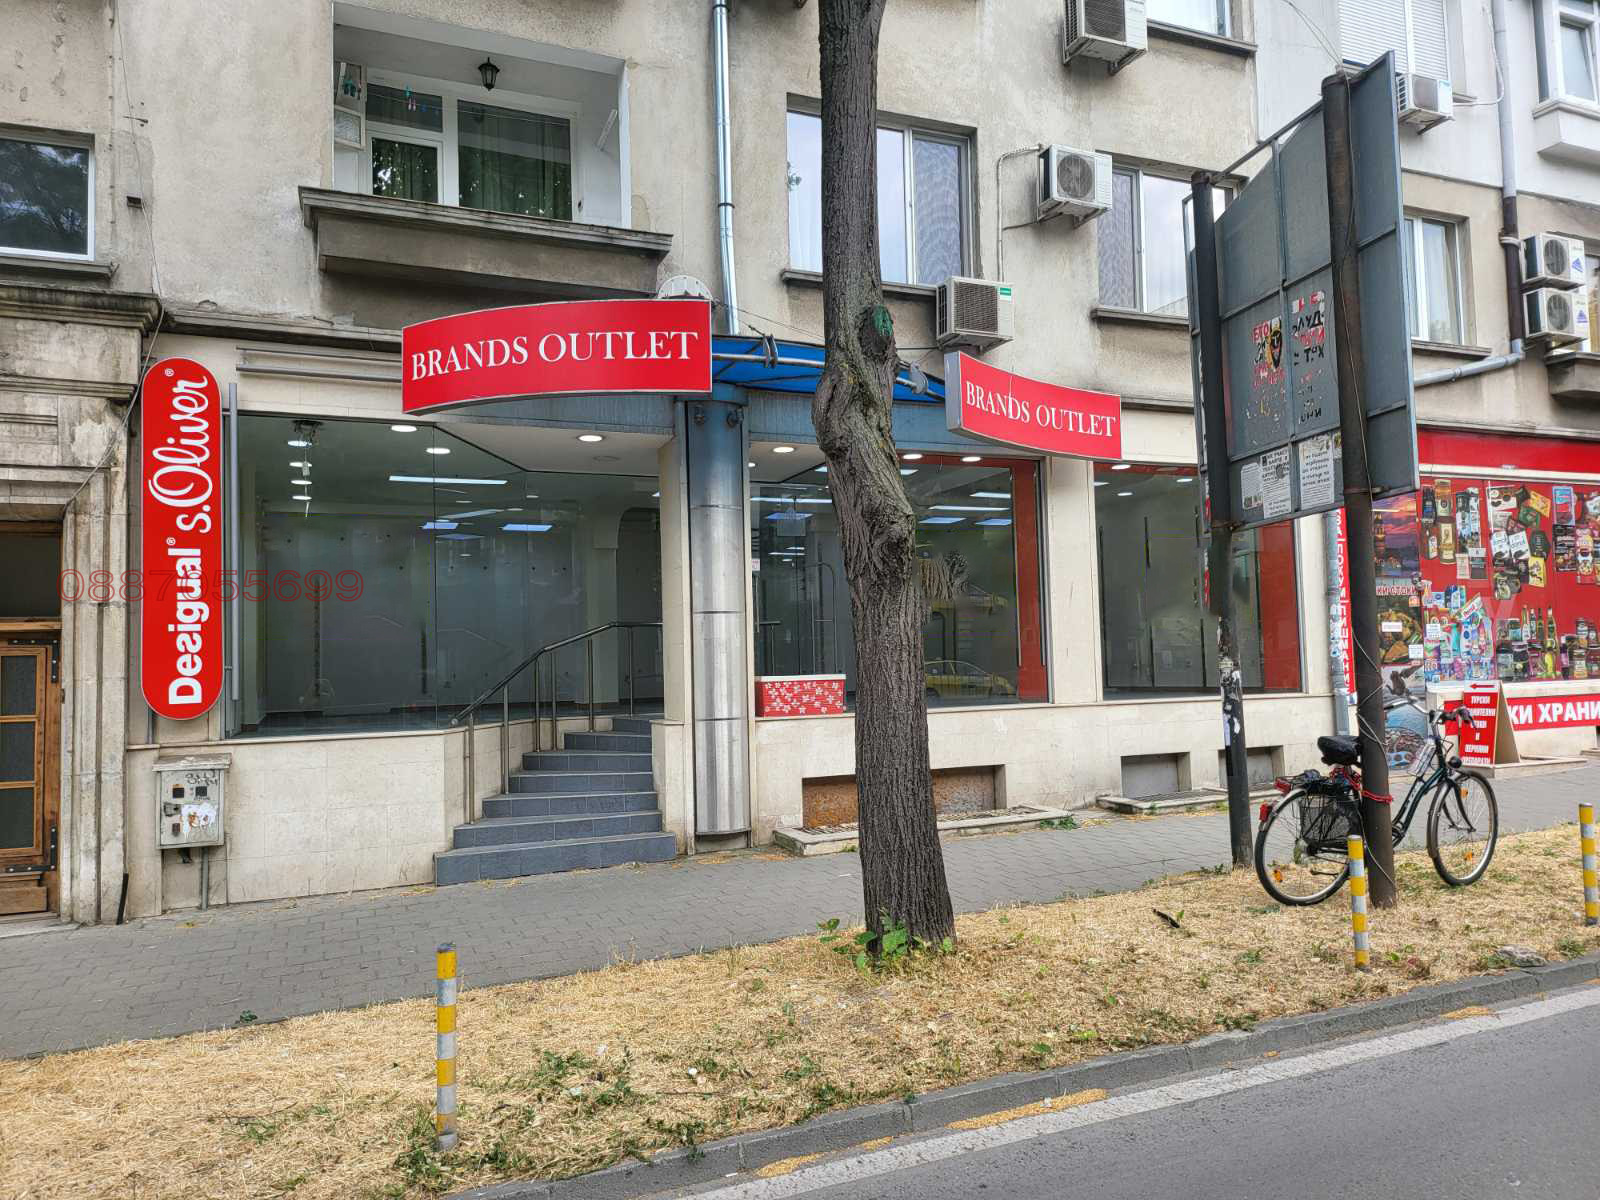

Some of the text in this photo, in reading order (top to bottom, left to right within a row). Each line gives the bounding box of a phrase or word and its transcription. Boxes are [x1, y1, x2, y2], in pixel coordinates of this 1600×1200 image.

[411, 331, 698, 381] BRANDS OUTLET
[965, 380, 1116, 437] BRANDS OUTLET
[167, 547, 210, 705] Desigual
